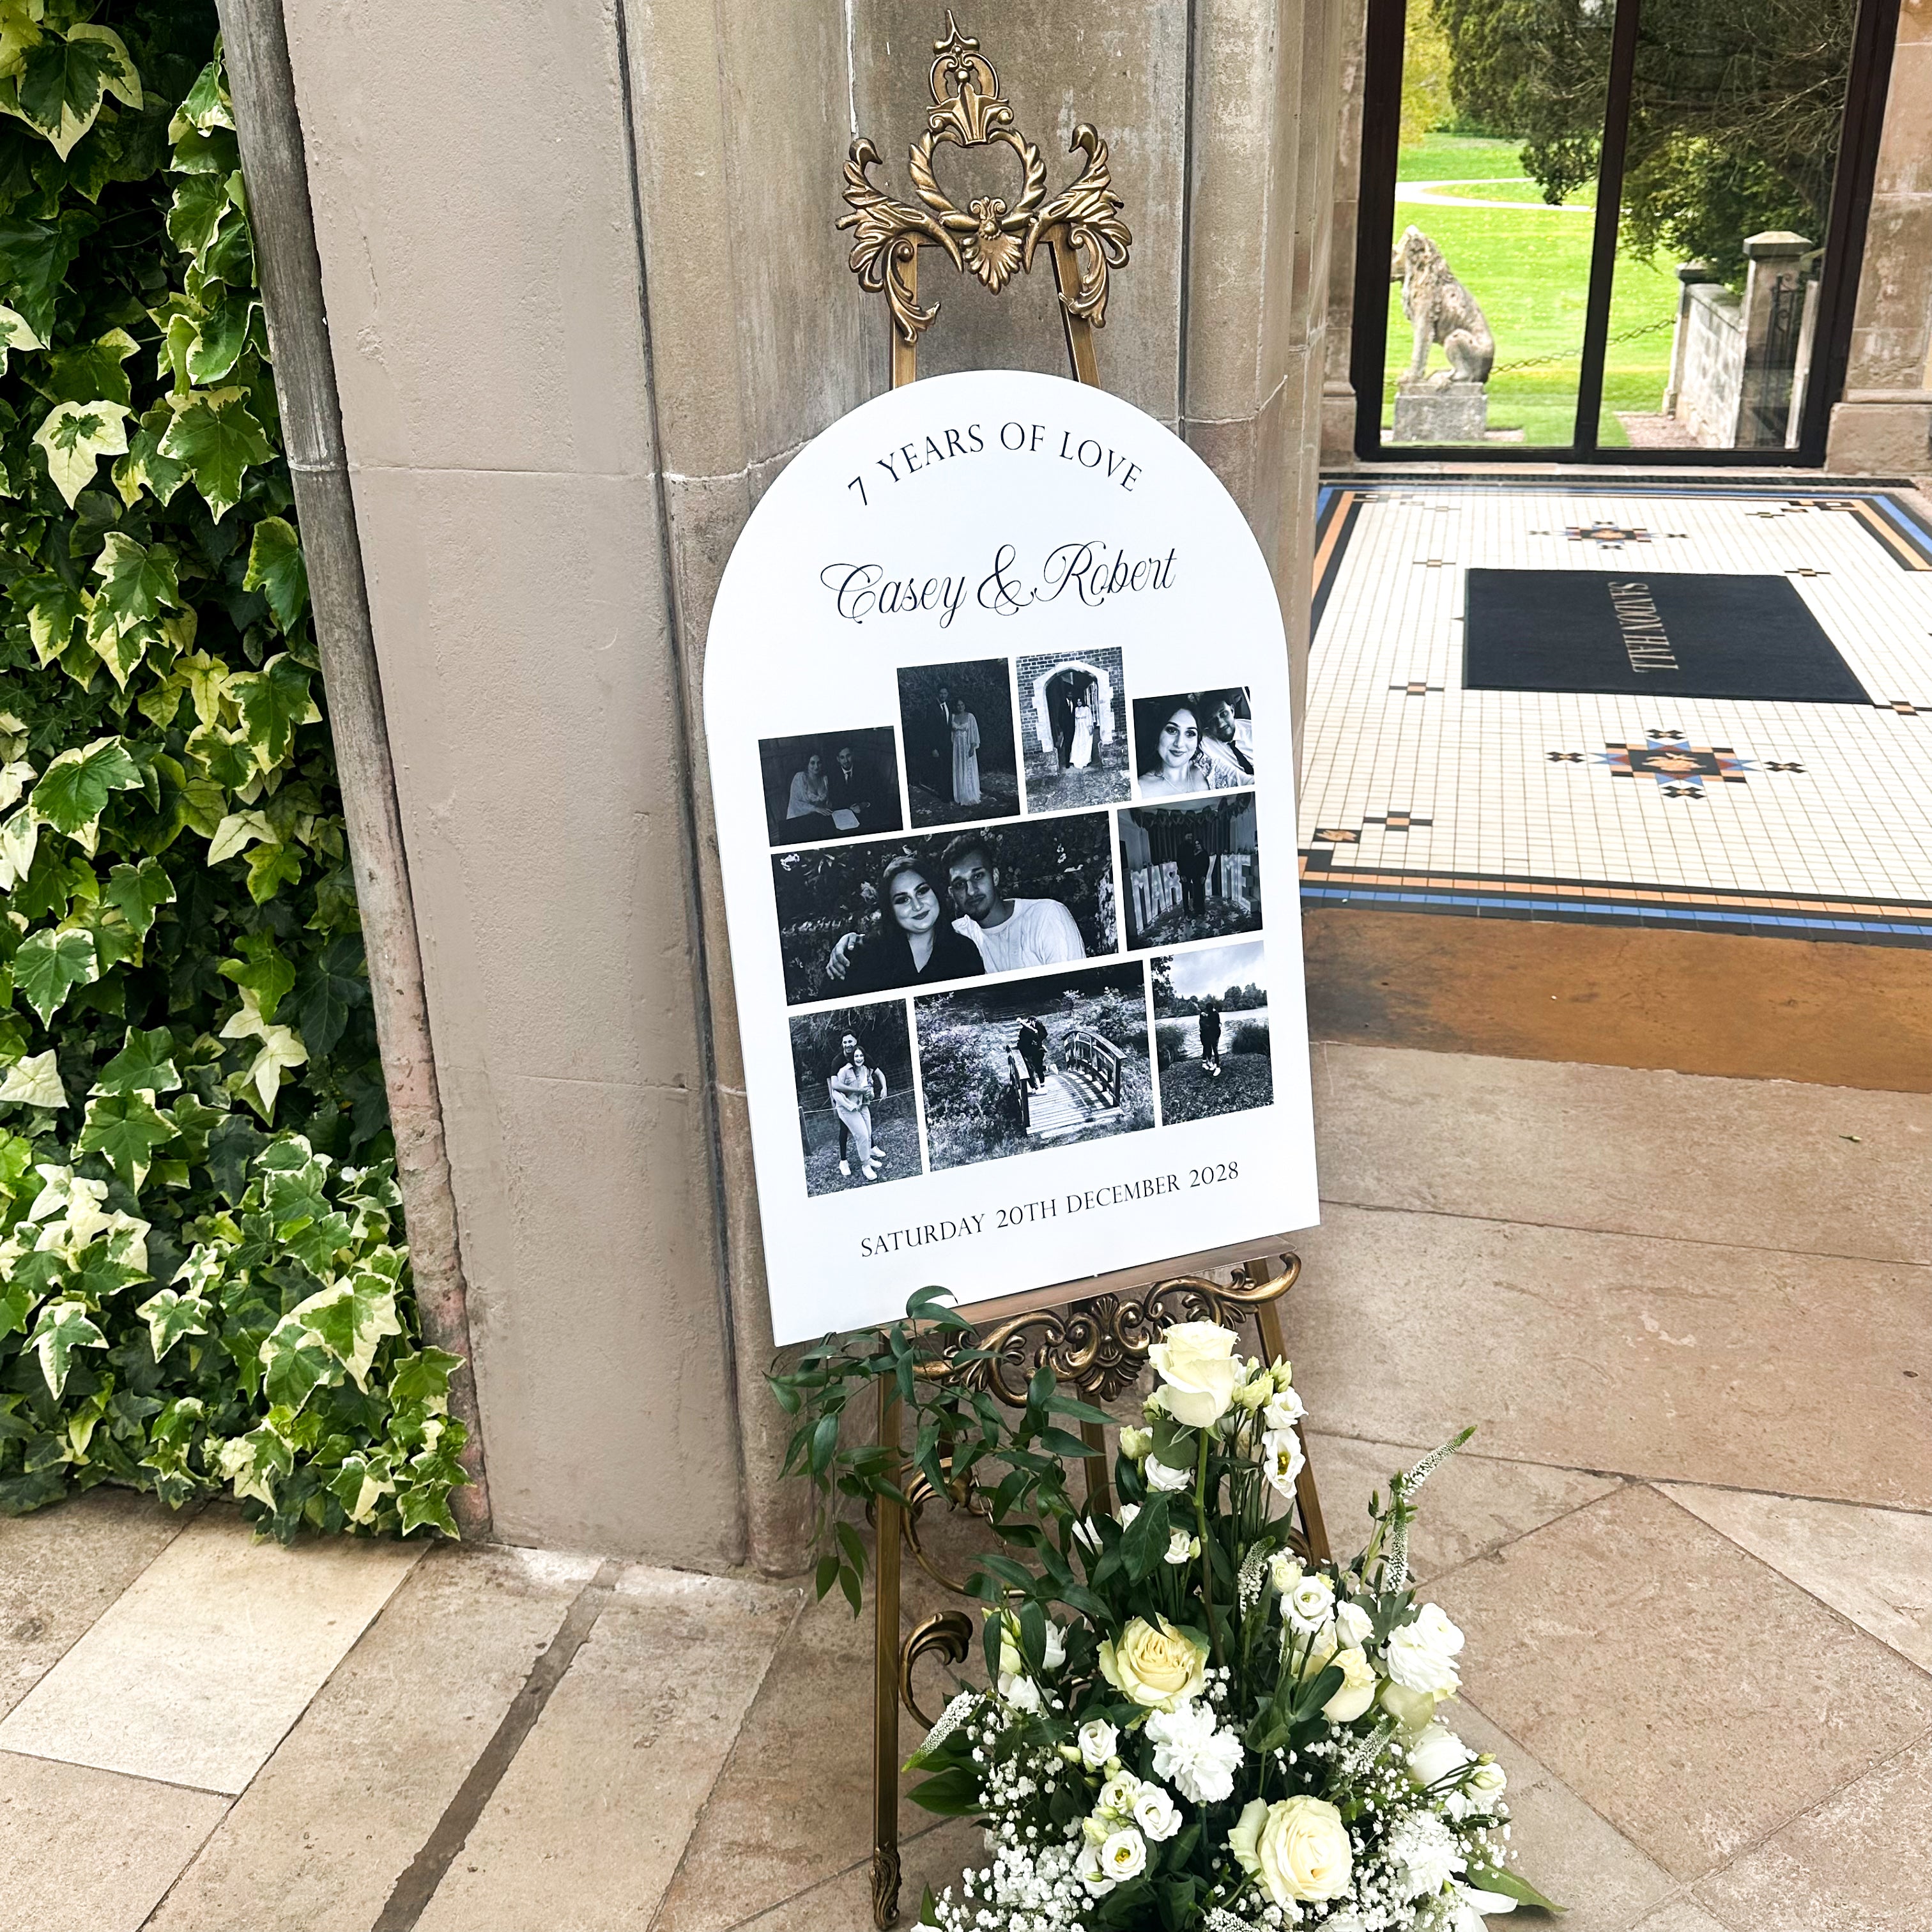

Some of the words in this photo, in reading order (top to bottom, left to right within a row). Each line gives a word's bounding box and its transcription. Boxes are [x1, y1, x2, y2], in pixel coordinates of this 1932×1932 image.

[847, 475, 868, 506] 7
[875, 424, 984, 482] YEARS
[1000, 422, 1045, 452] OF
[1059, 431, 1142, 492] LOVE
[820, 563, 967, 629] Casey
[977, 544, 1034, 617] &
[1034, 540, 1177, 607] Robert
[1607, 581, 1665, 632] SANDON
[1622, 634, 1679, 673] HALL
[1130, 854, 1216, 933] MARY
[1220, 854, 1252, 912] ME
[861, 1213, 985, 1257] SATURDAY
[996, 1199, 1057, 1229] 20TH
[1066, 1174, 1181, 1214] DECEMBER
[1189, 1161, 1238, 1188] 2028
